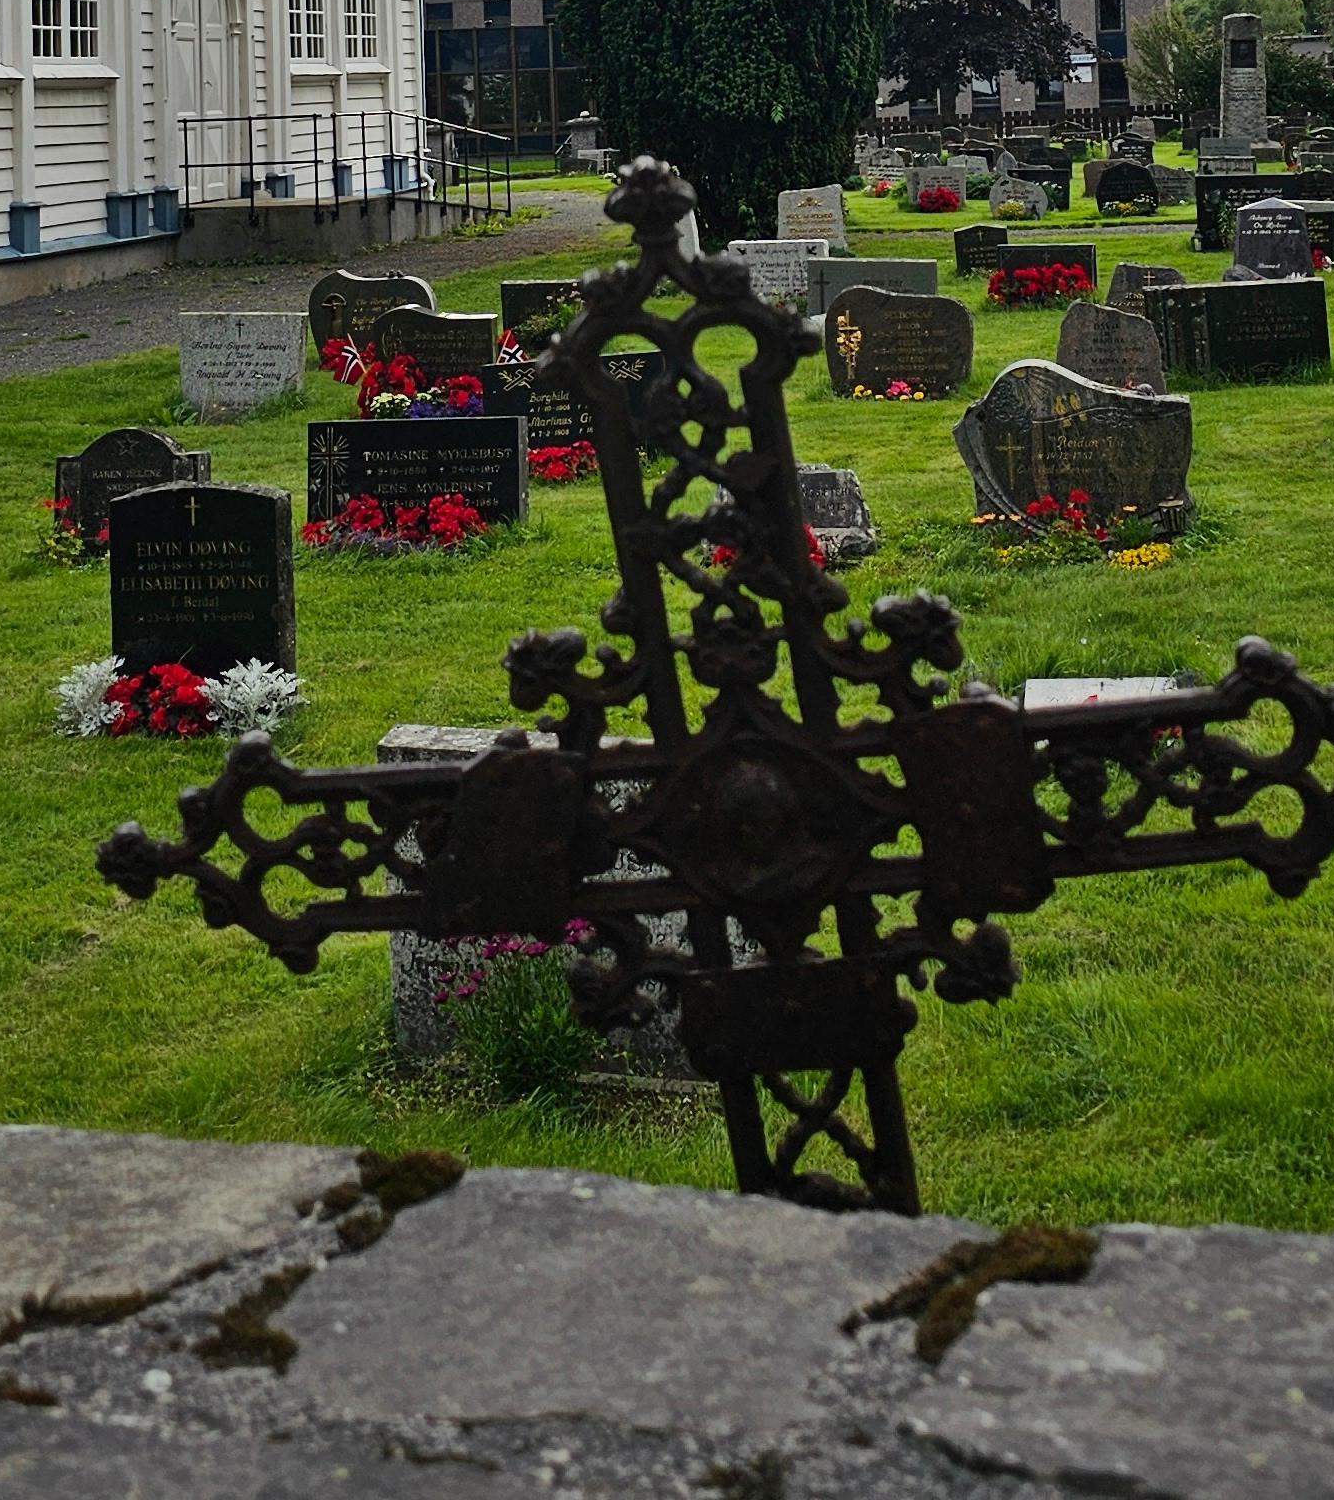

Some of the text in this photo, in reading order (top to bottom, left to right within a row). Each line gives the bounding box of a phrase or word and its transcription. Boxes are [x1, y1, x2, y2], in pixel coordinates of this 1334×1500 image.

[528, 415, 573, 428] Martinus
[362, 447, 513, 462] TOMASINE MYKLEBUST
[136, 538, 252, 557] ELVIN DØVING
[120, 573, 270, 592] ELISABETH DØVING
